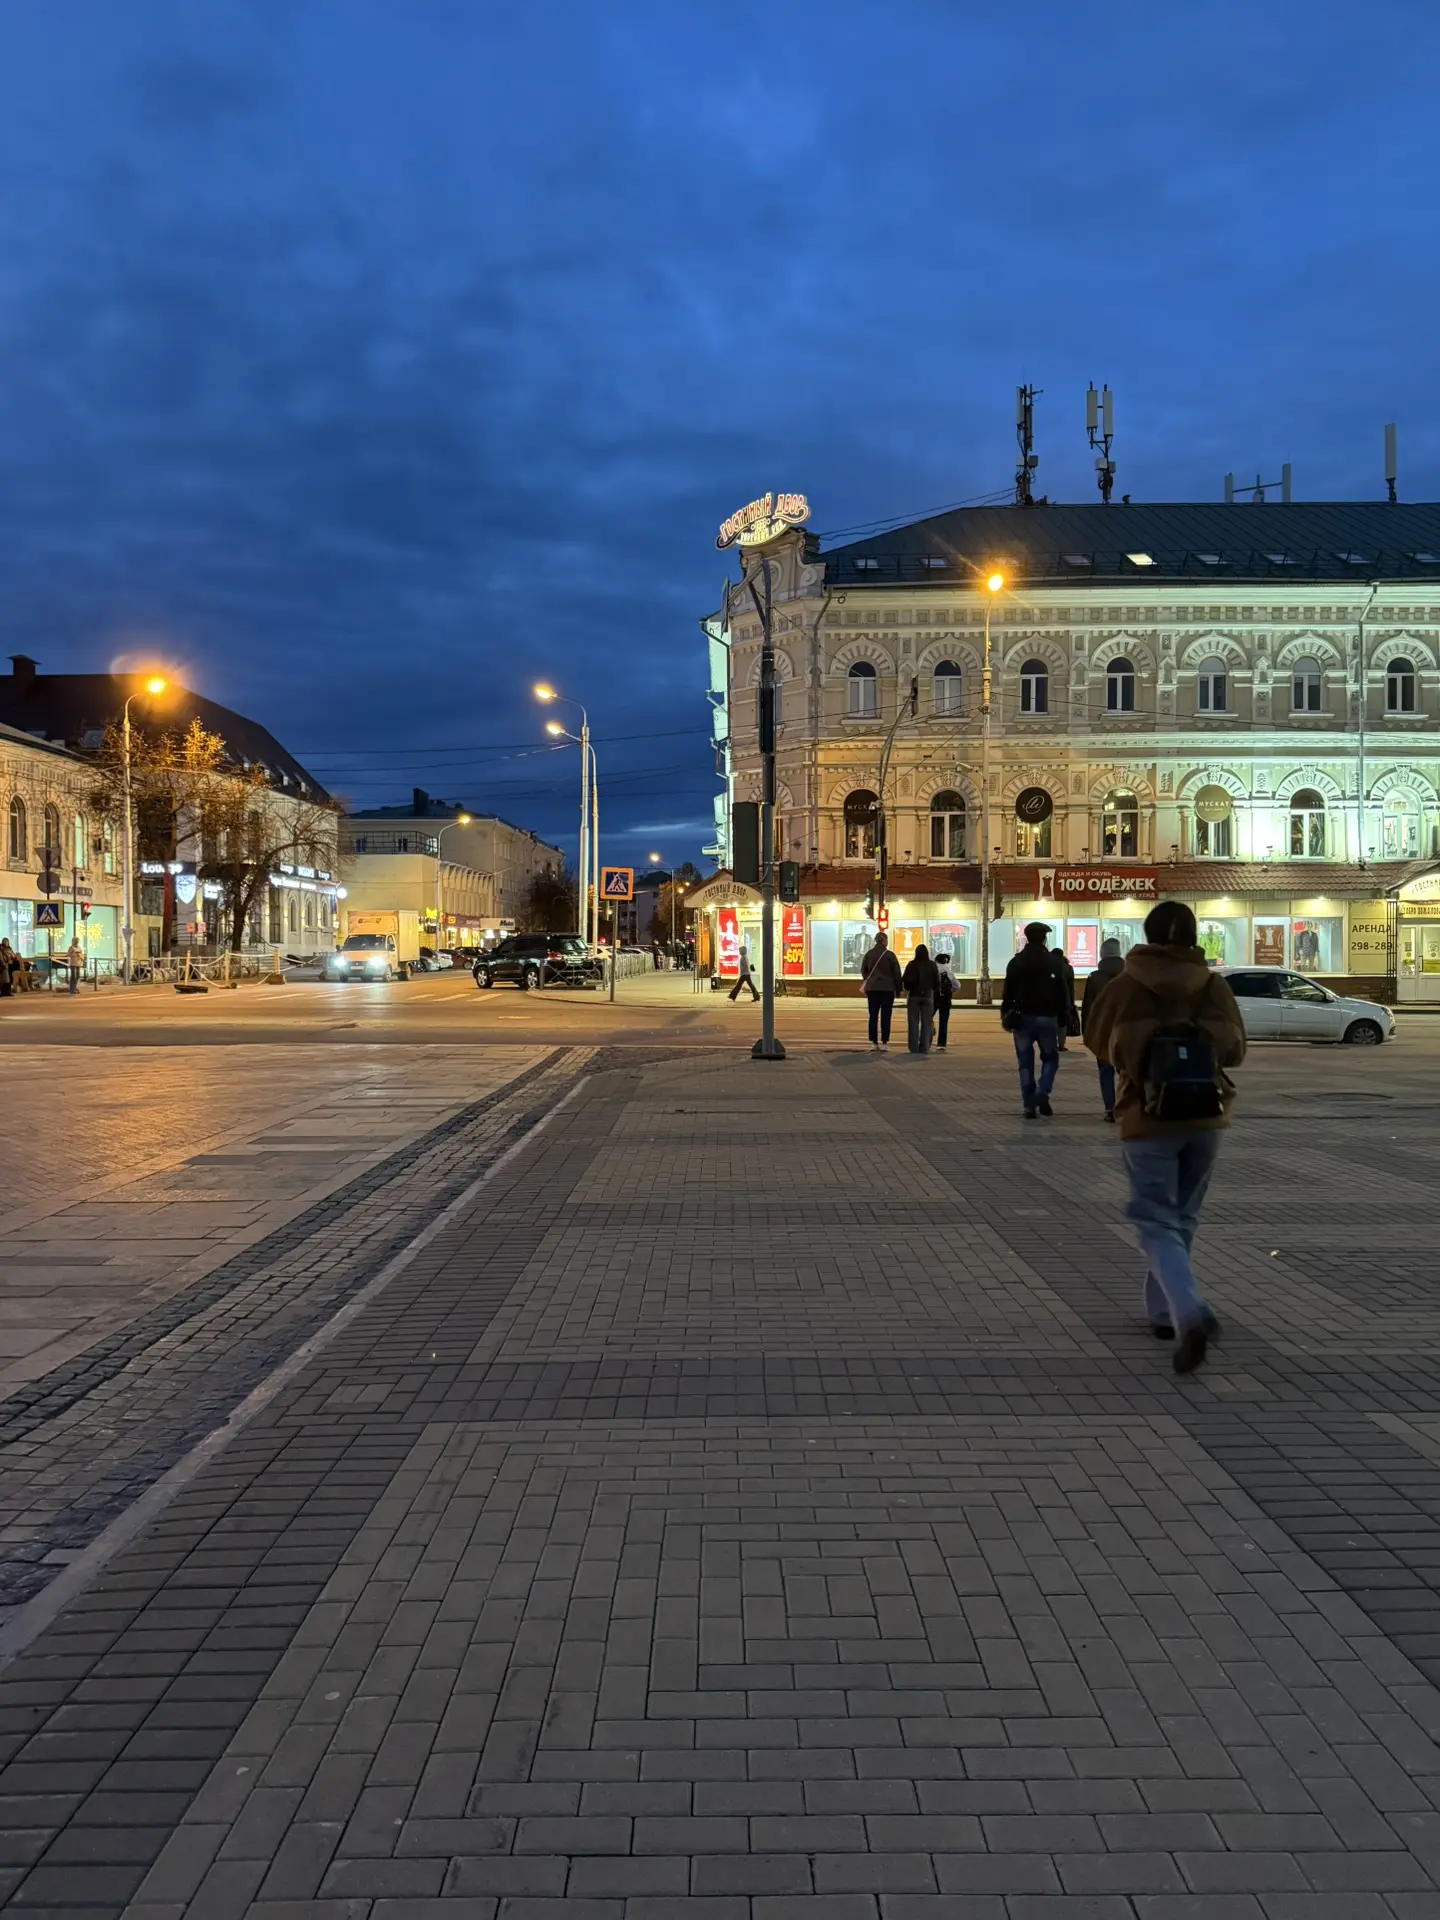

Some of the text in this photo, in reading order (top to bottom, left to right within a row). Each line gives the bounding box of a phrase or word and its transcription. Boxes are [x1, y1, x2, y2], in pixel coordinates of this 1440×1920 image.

[720, 492, 807, 542] ГОСТИНЫЙ ДВОР
[732, 884, 747, 897] ДВОР
[1058, 875, 1156, 894] 100 ОДЁЖЕК
[1351, 924, 1392, 934] АРЕНДА
[1351, 941, 1393, 951] 298-289
[783, 948, 805, 964] -60%
